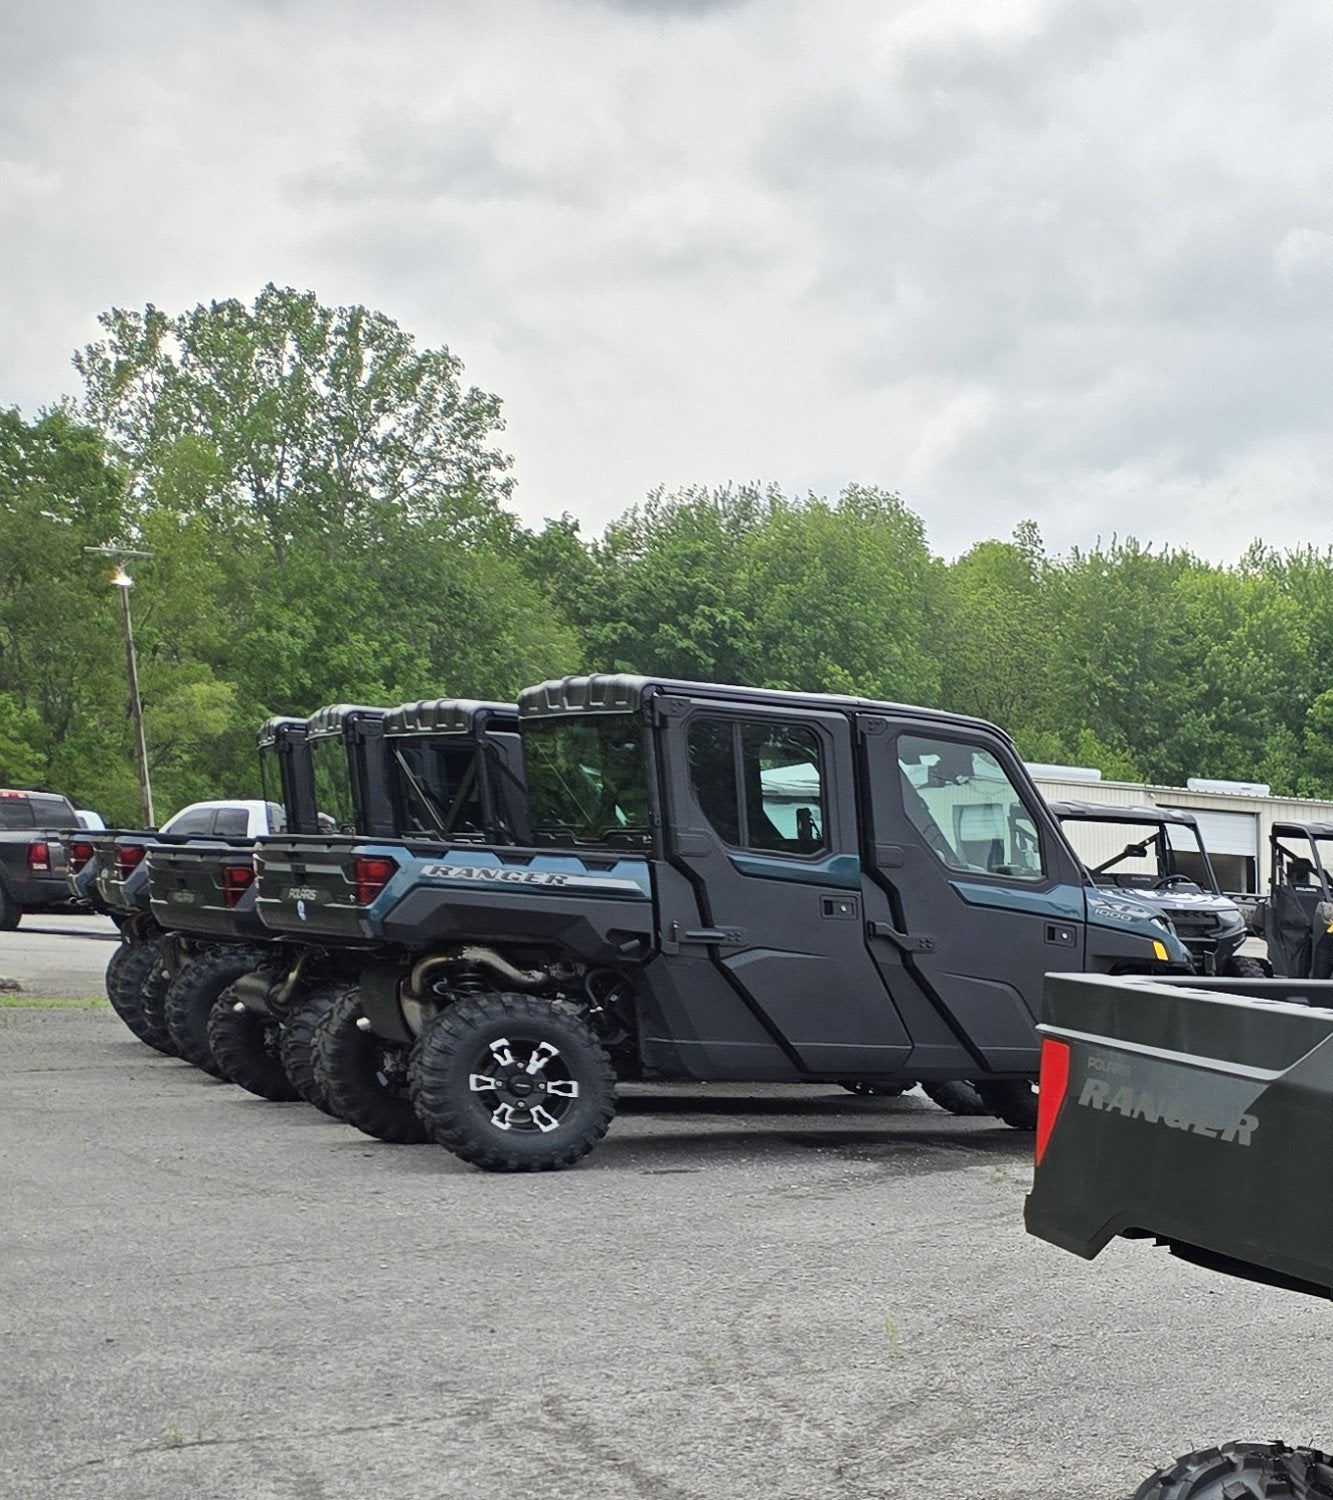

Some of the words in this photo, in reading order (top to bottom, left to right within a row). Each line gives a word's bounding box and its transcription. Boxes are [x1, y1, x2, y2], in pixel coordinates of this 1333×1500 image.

[428, 865, 569, 886] RANGER
[1094, 908, 1132, 921] 1000
[1078, 1077, 1260, 1146] RANGER
